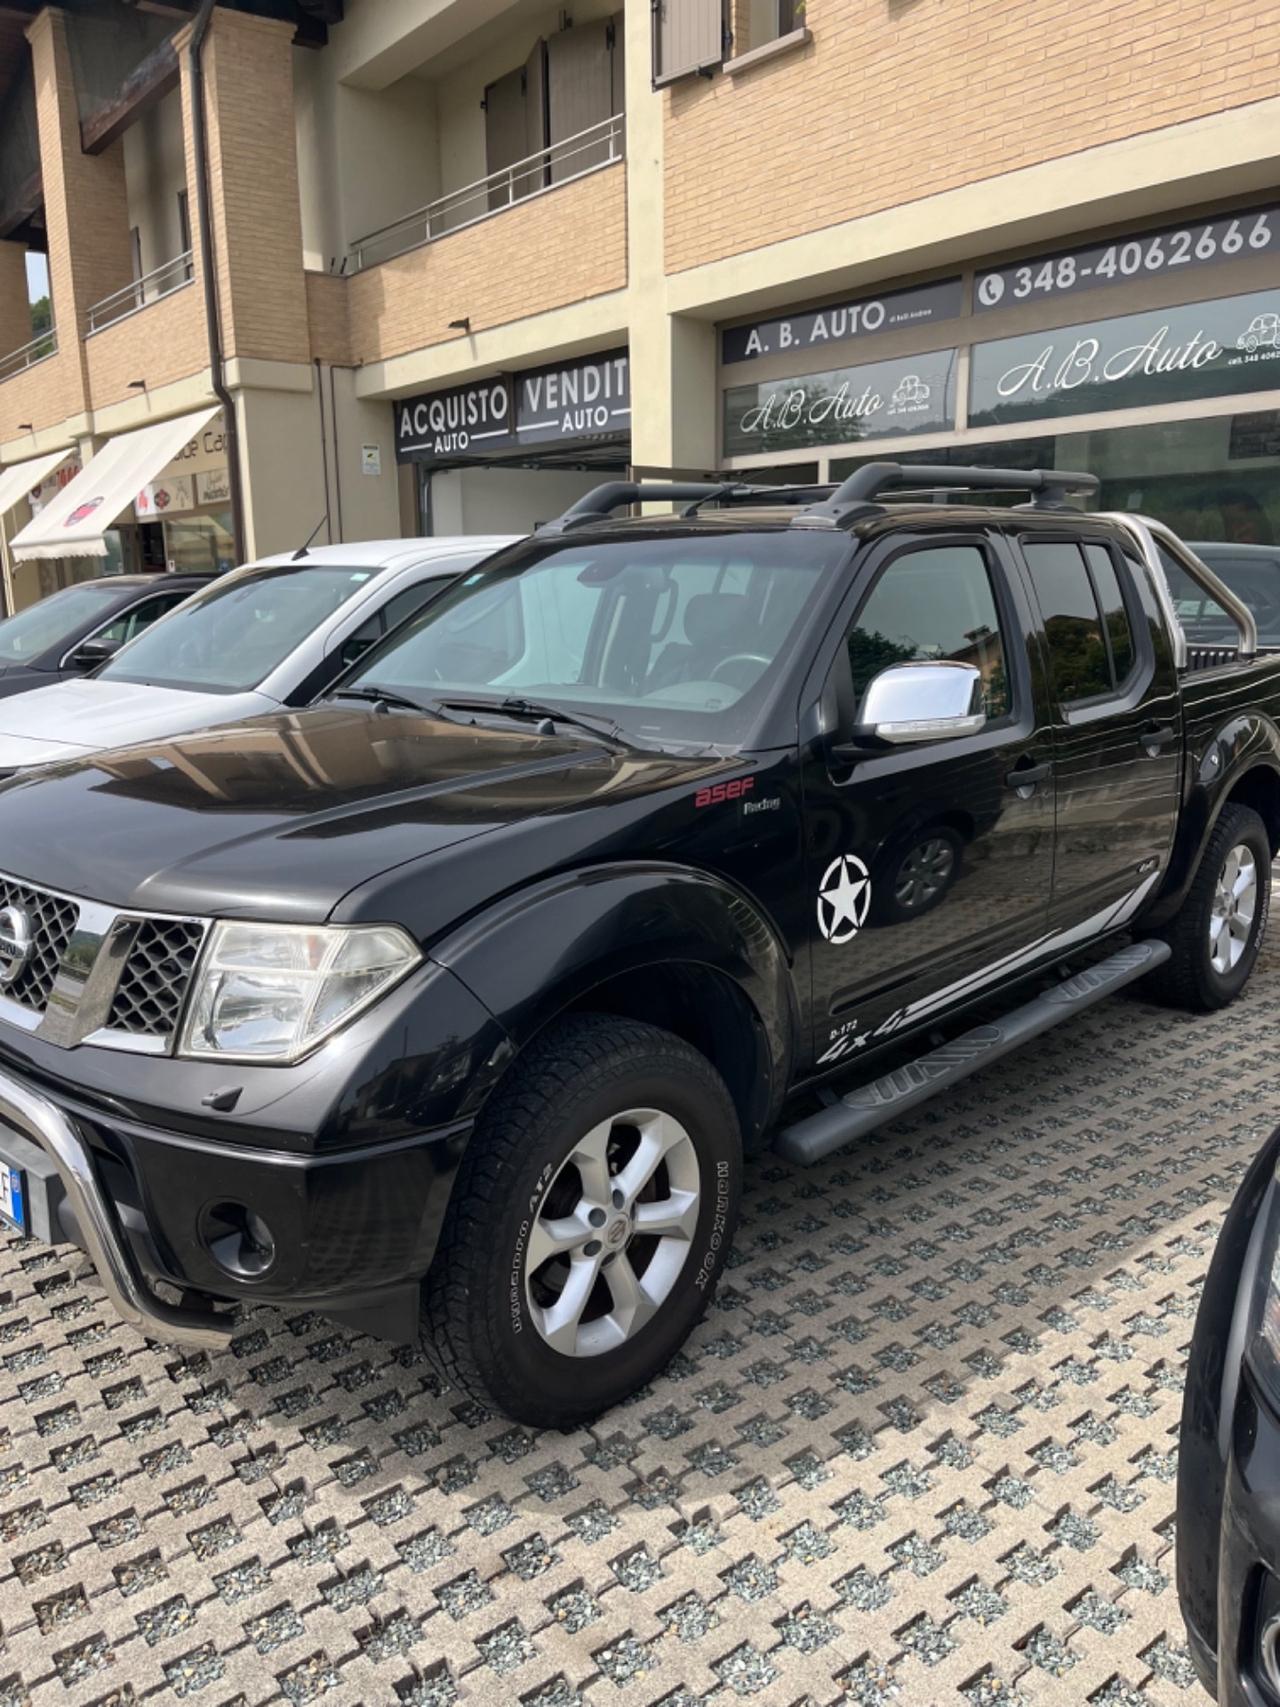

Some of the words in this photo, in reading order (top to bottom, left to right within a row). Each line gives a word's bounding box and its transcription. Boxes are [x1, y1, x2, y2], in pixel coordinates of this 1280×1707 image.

[1012, 214, 1272, 299] 348-4062666
[745, 328, 770, 358] A.
[778, 322, 800, 349] B.
[809, 300, 886, 343] AUTO
[399, 385, 509, 439] ACQUISTO
[561, 405, 609, 433] AUTO
[434, 431, 470, 454] AUTO
